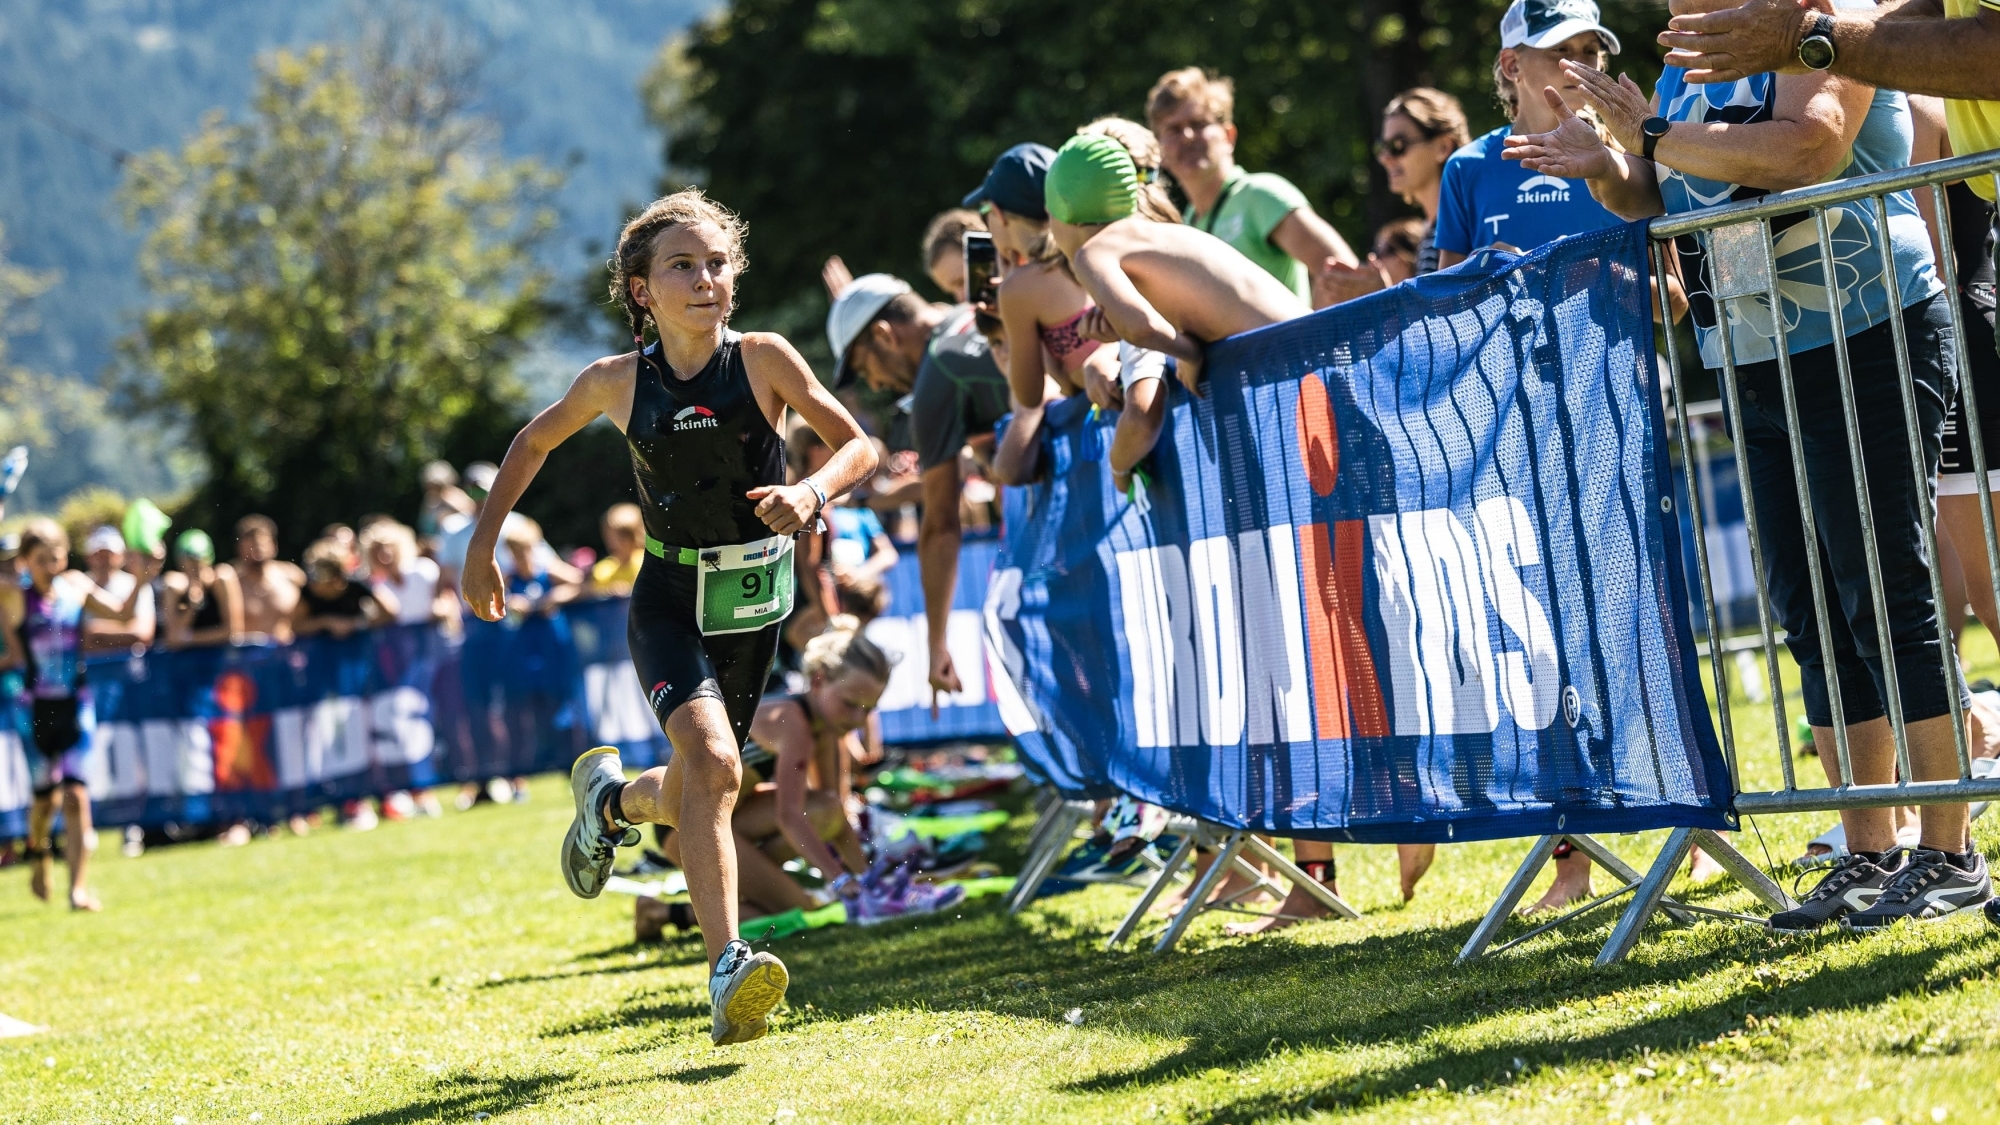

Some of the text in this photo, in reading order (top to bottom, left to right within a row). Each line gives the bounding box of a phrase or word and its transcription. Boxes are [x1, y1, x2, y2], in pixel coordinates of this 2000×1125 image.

[1516, 190, 1570, 203] skinfit
[673, 418, 718, 431] skinfit
[743, 546, 778, 561] IRONKIDS
[741, 569, 774, 599] 91
[754, 607, 768, 615] MIA
